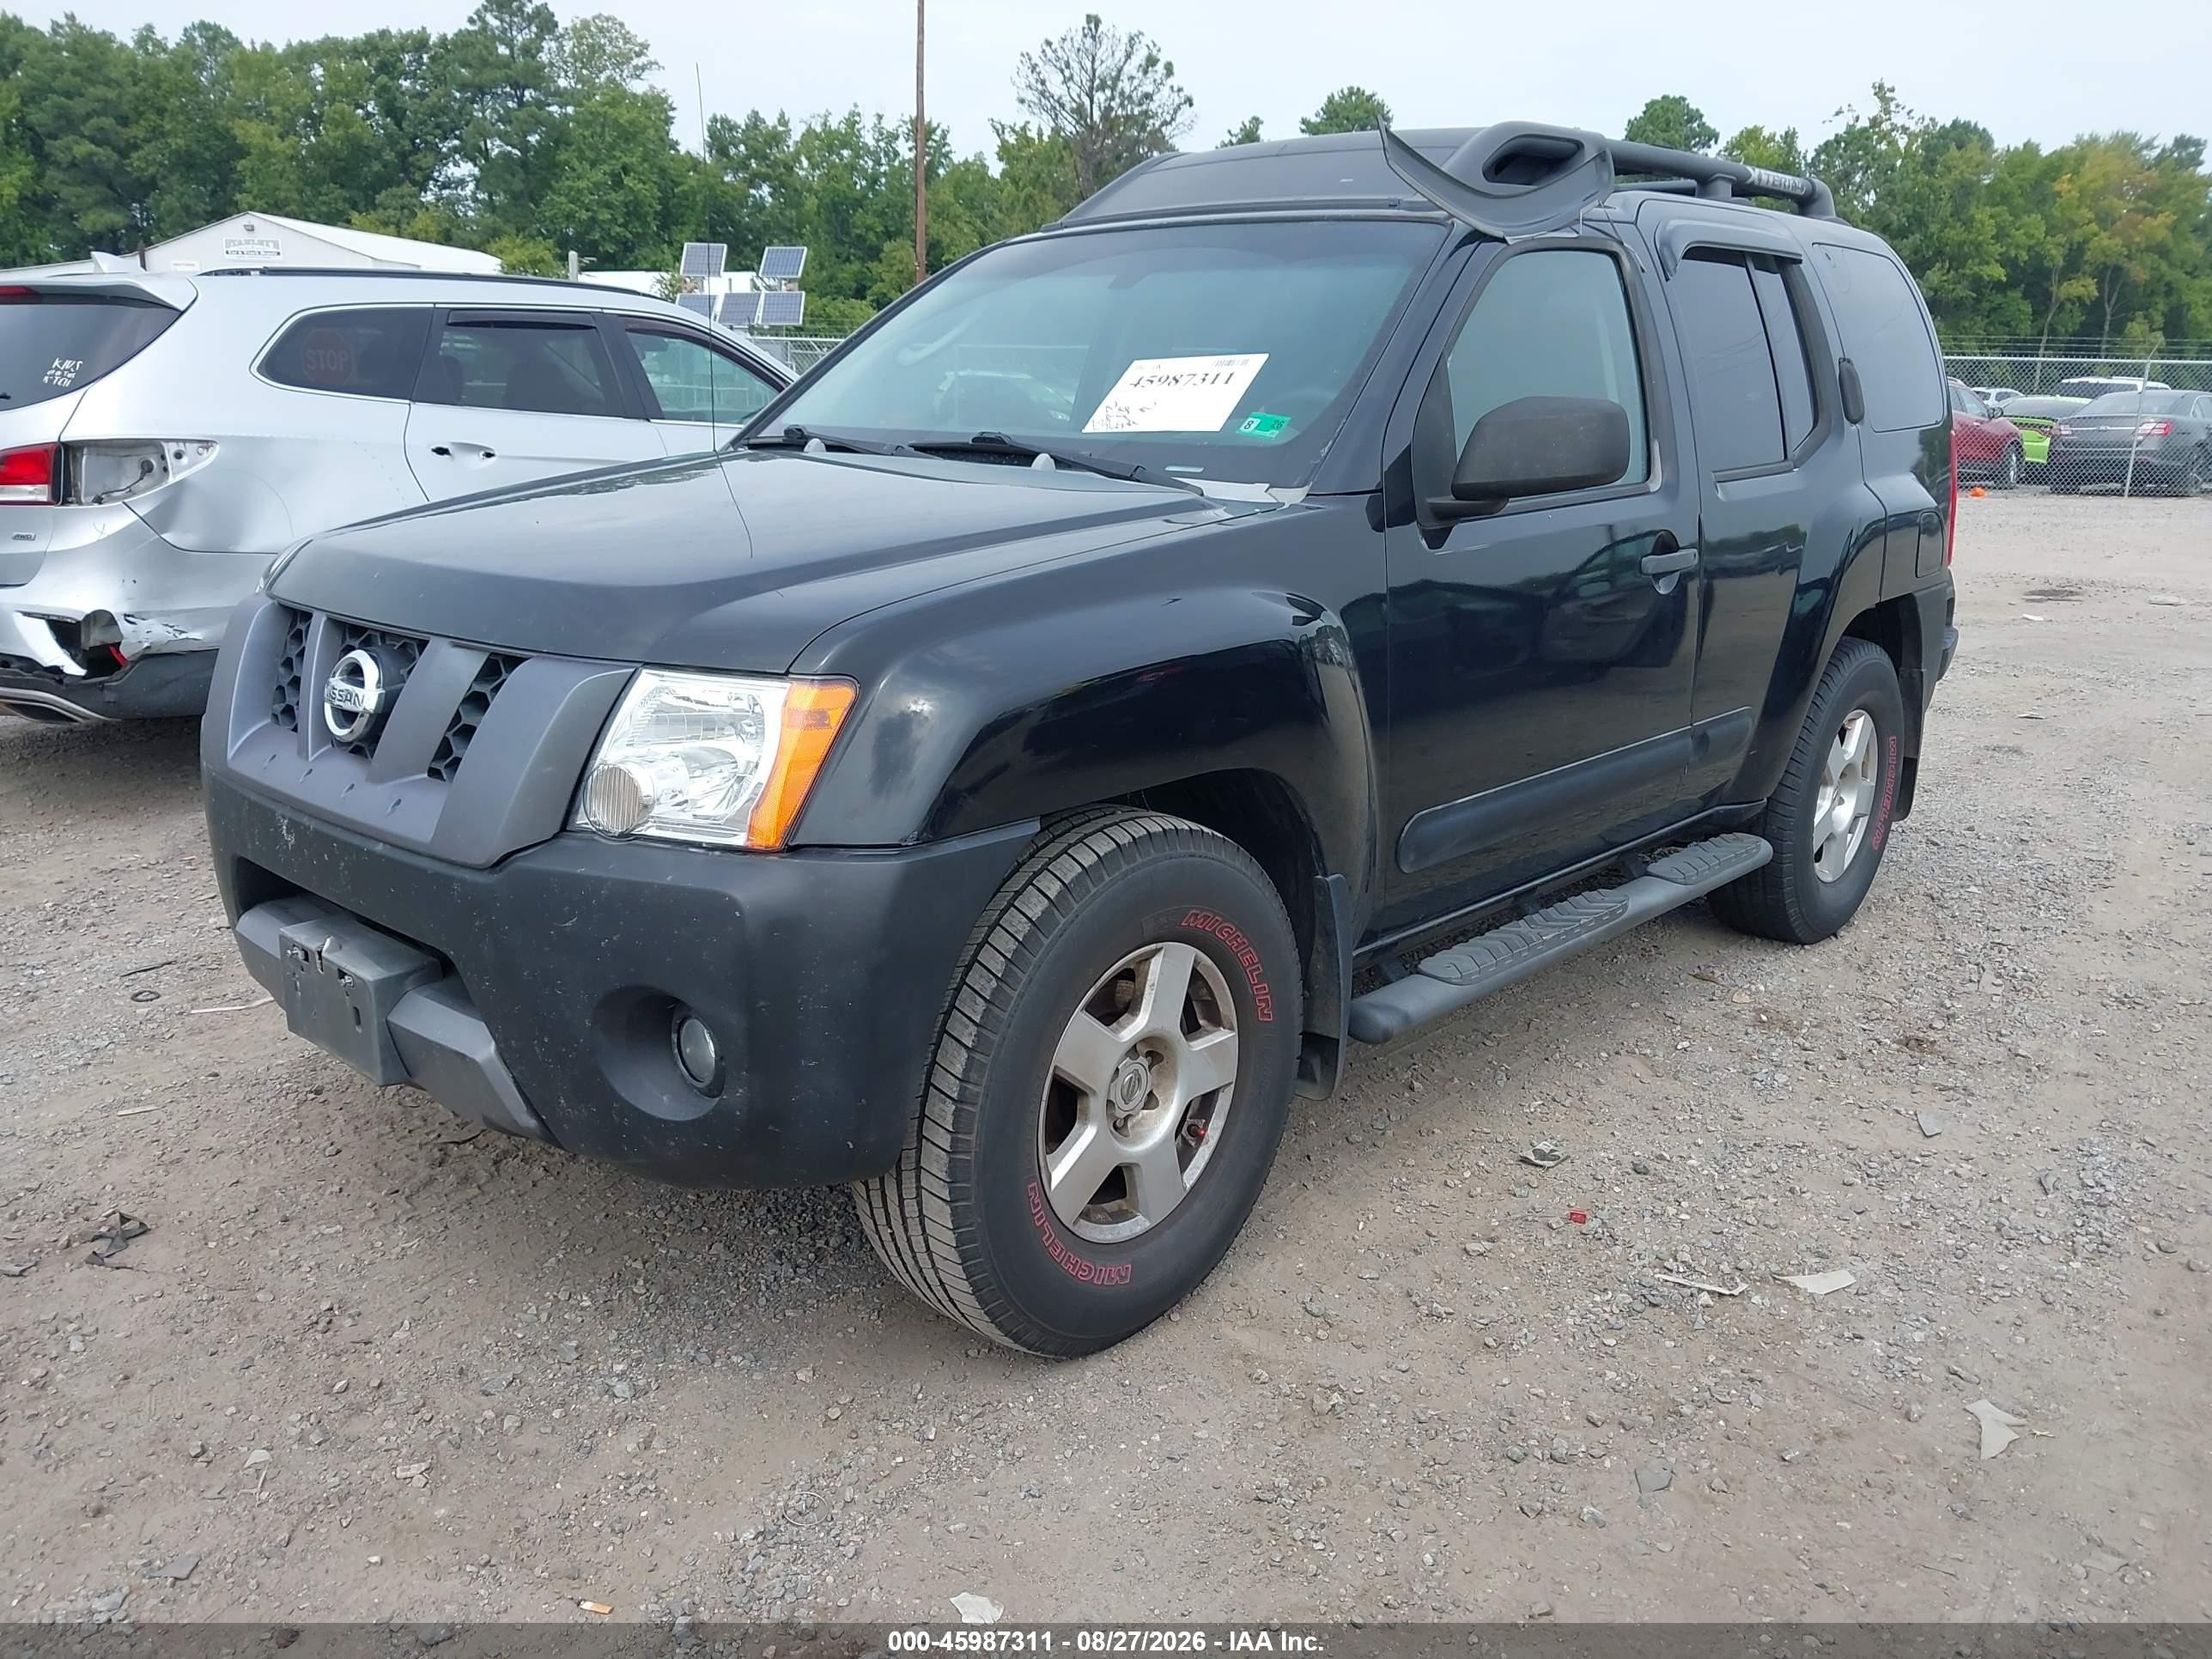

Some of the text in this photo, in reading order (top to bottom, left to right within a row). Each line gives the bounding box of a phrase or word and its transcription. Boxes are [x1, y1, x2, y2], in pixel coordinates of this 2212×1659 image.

[306, 349, 349, 372] STOP
[1129, 372, 1236, 388] 45987311
[1243, 419, 1285, 430] 8 26
[1872, 736, 1897, 851] MICHELIN
[1181, 909, 1273, 1022] MICHELIN
[1027, 1181, 1132, 1285] MICHELIN
